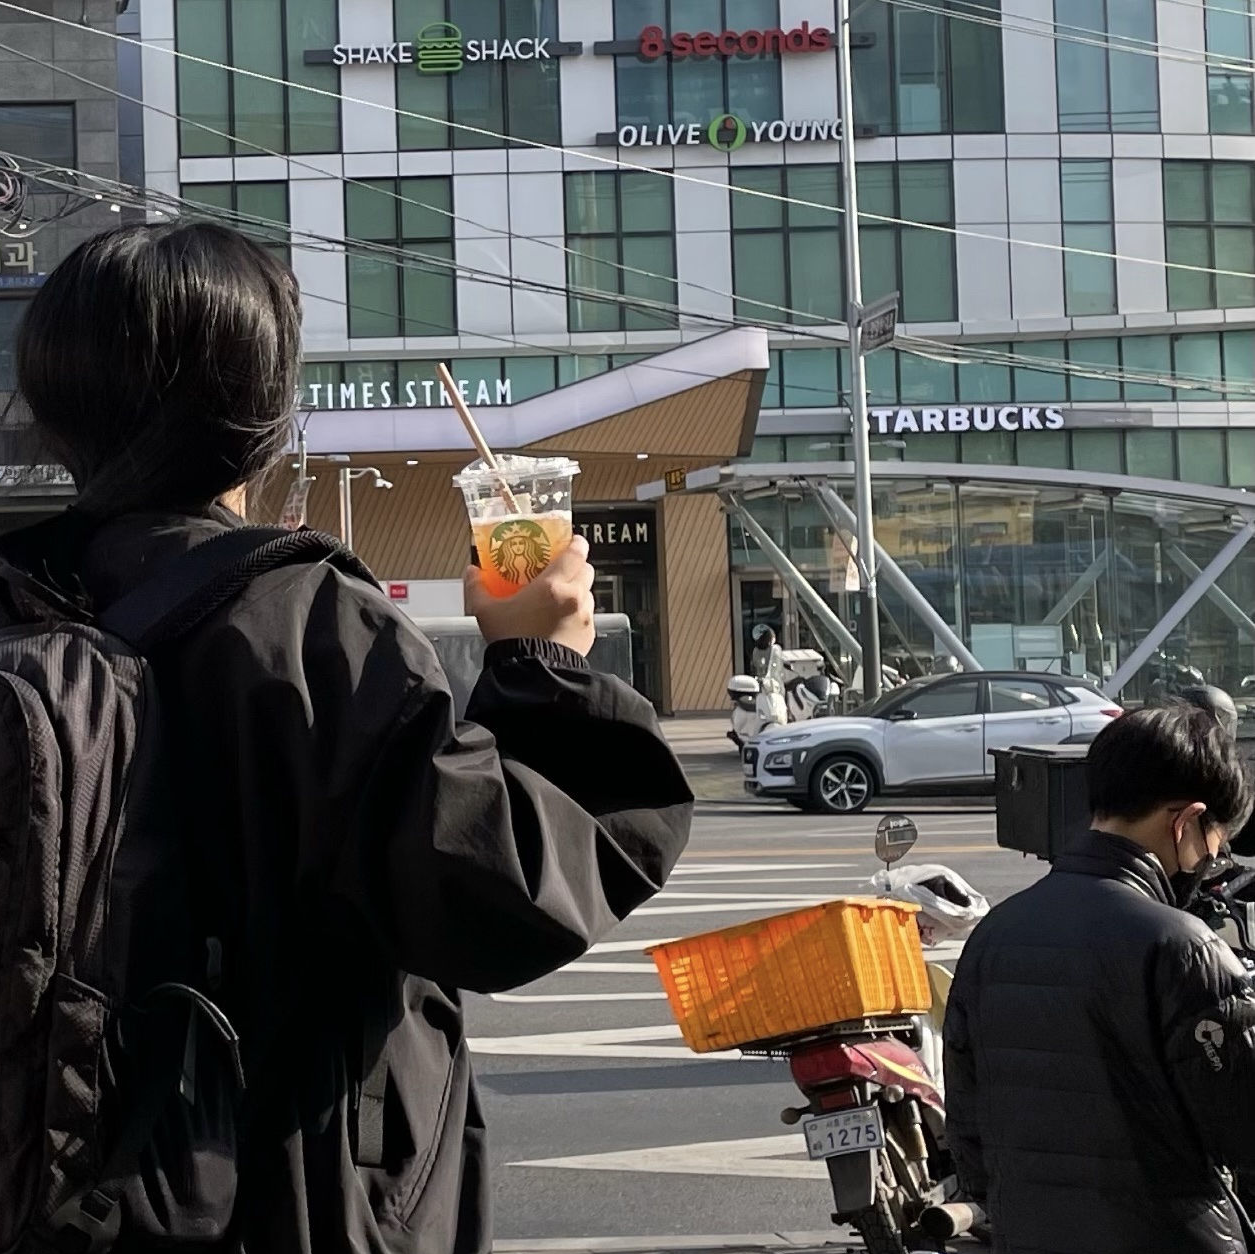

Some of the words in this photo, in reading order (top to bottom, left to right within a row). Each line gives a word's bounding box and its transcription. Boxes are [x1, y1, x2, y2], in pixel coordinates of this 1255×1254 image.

[333, 42, 413, 65] SHAKE
[466, 37, 550, 62] SHACK
[618, 123, 701, 147] OLIVE
[309, 381, 392, 409] TIMES
[573, 522, 648, 544] TREAM
[826, 1123, 877, 1149] 1275
